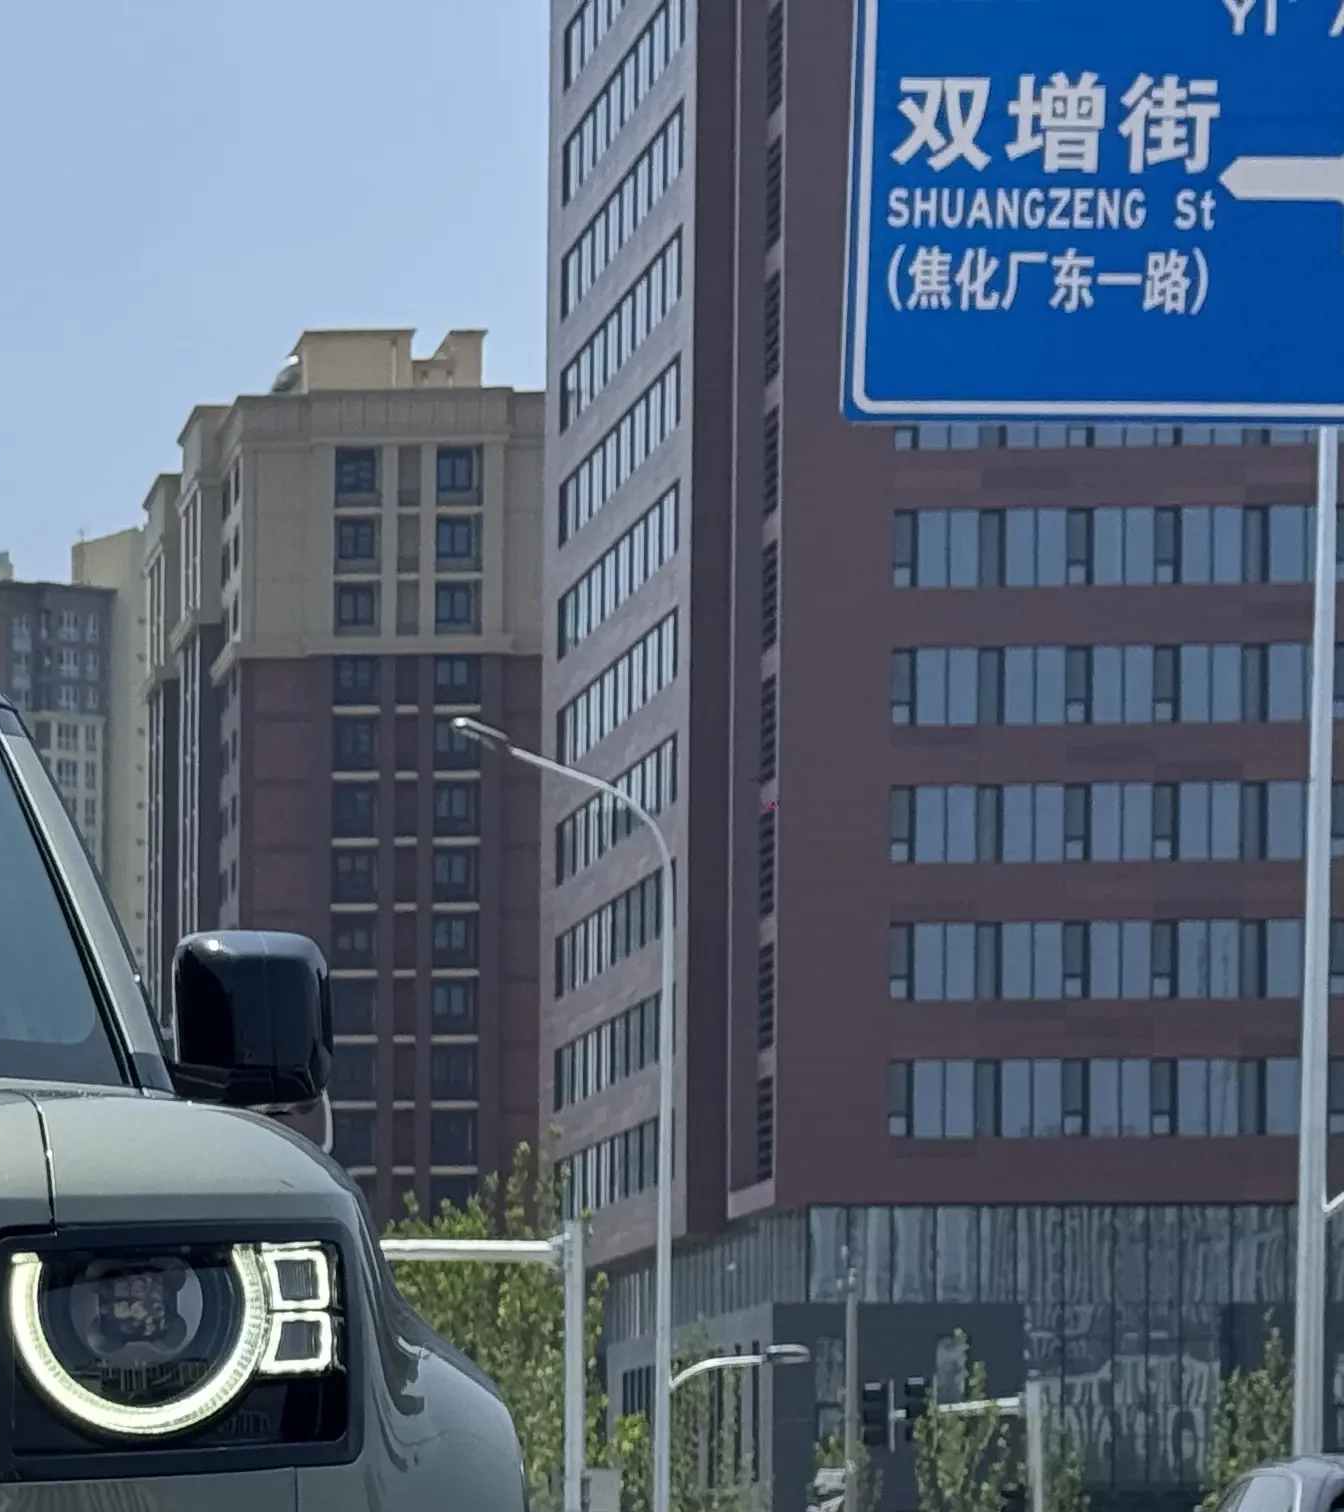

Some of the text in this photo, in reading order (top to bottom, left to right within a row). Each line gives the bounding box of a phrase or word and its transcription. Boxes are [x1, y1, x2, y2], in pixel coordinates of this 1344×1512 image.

[889, 71, 1221, 175] 双增街
[886, 187, 1216, 231] SHUANGZENG St
[886, 243, 1210, 315] (焦化厂东一路)
